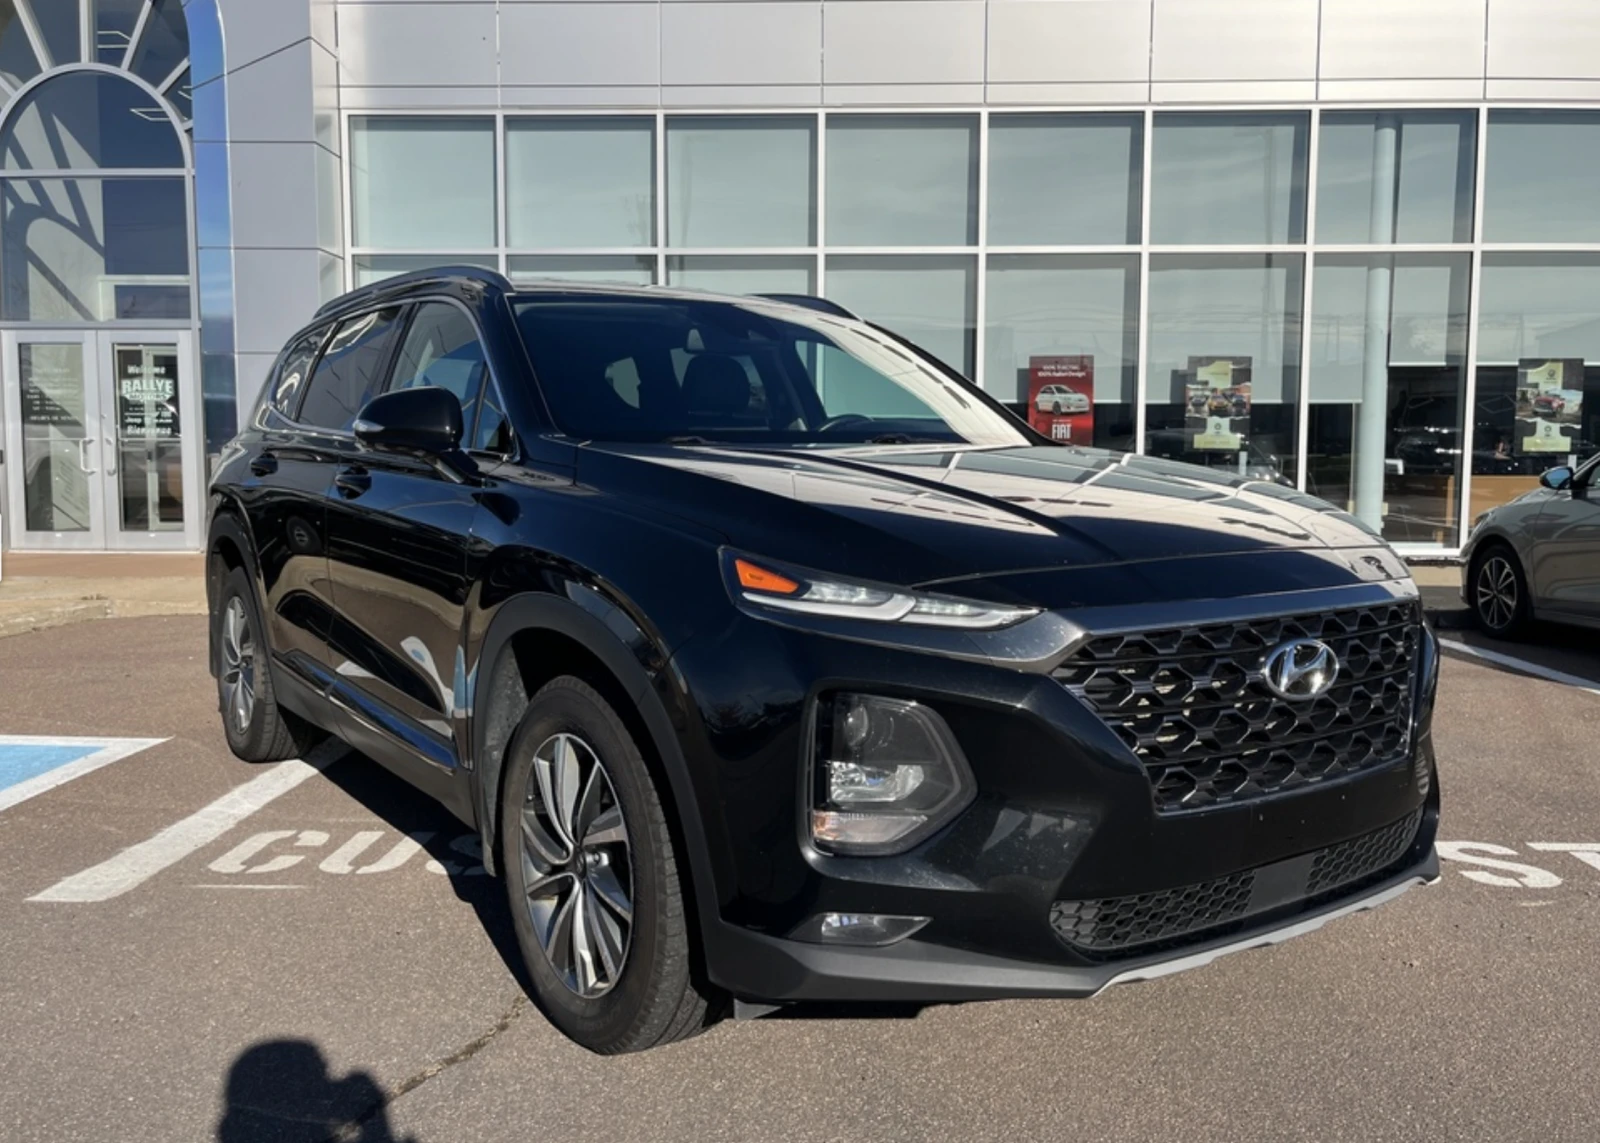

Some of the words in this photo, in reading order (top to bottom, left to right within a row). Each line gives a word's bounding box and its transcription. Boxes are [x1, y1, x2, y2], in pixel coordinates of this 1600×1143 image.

[127, 365, 166, 374] Welcome
[121, 379, 174, 395] RALLYE
[1052, 424, 1072, 439] FIAT
